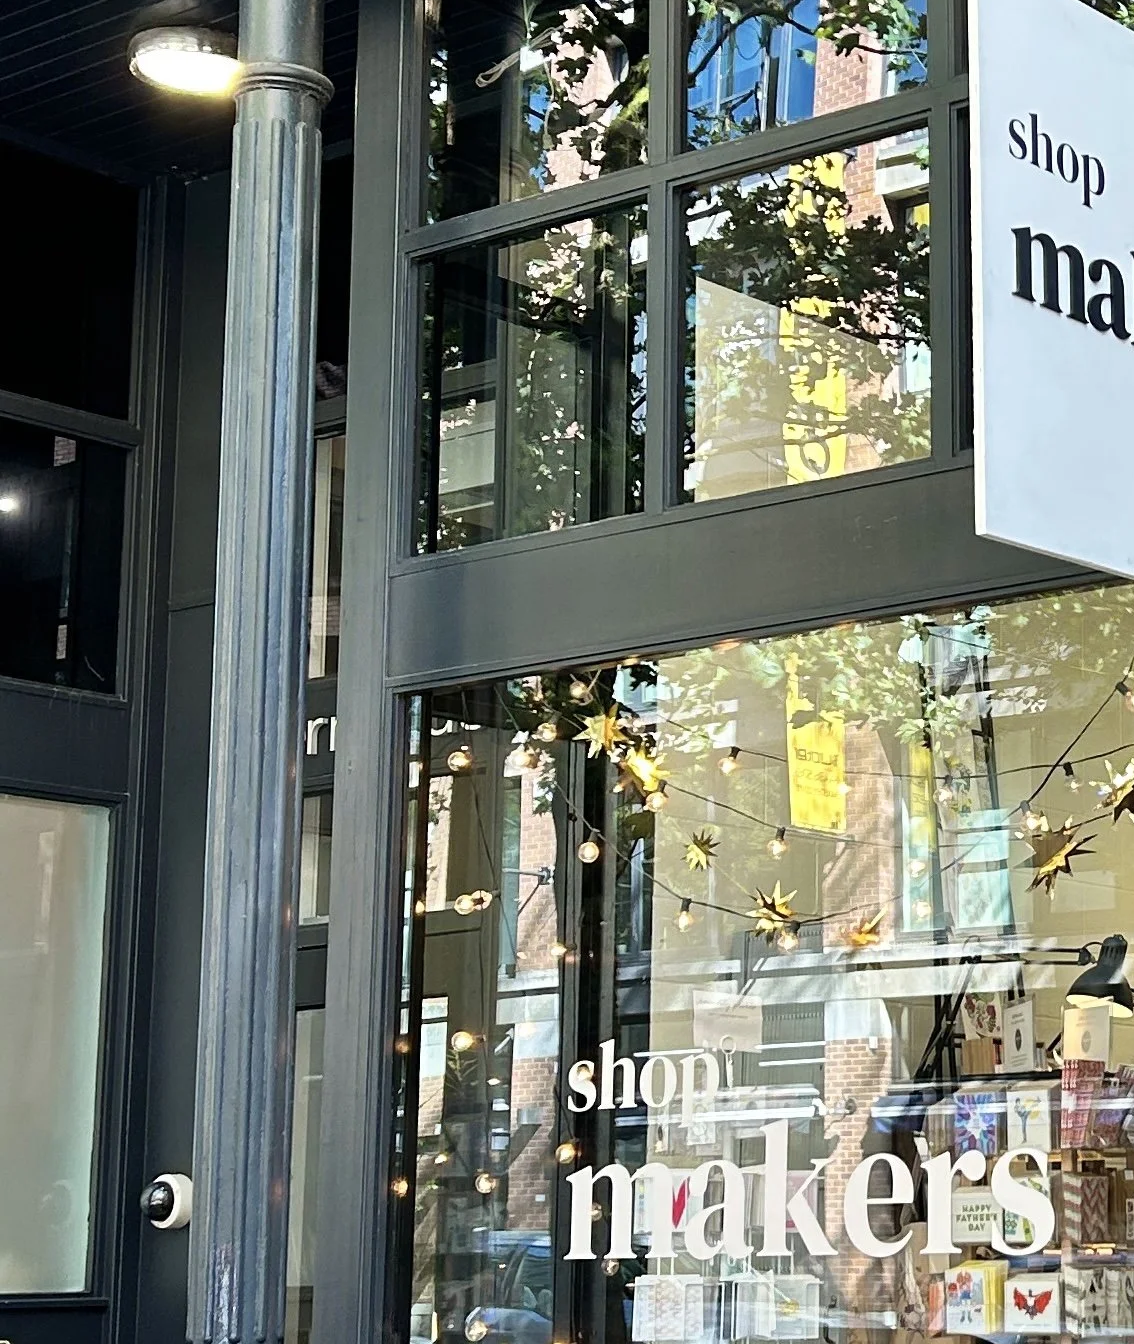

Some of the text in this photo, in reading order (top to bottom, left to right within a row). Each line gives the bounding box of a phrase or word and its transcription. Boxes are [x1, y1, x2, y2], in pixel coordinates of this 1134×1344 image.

[1008, 112, 1106, 209] shop
[566, 1040, 720, 1128] shop
[563, 1118, 1057, 1262] makers
[962, 1203, 992, 1213] HAPPY
[968, 1222, 986, 1232] DAY
